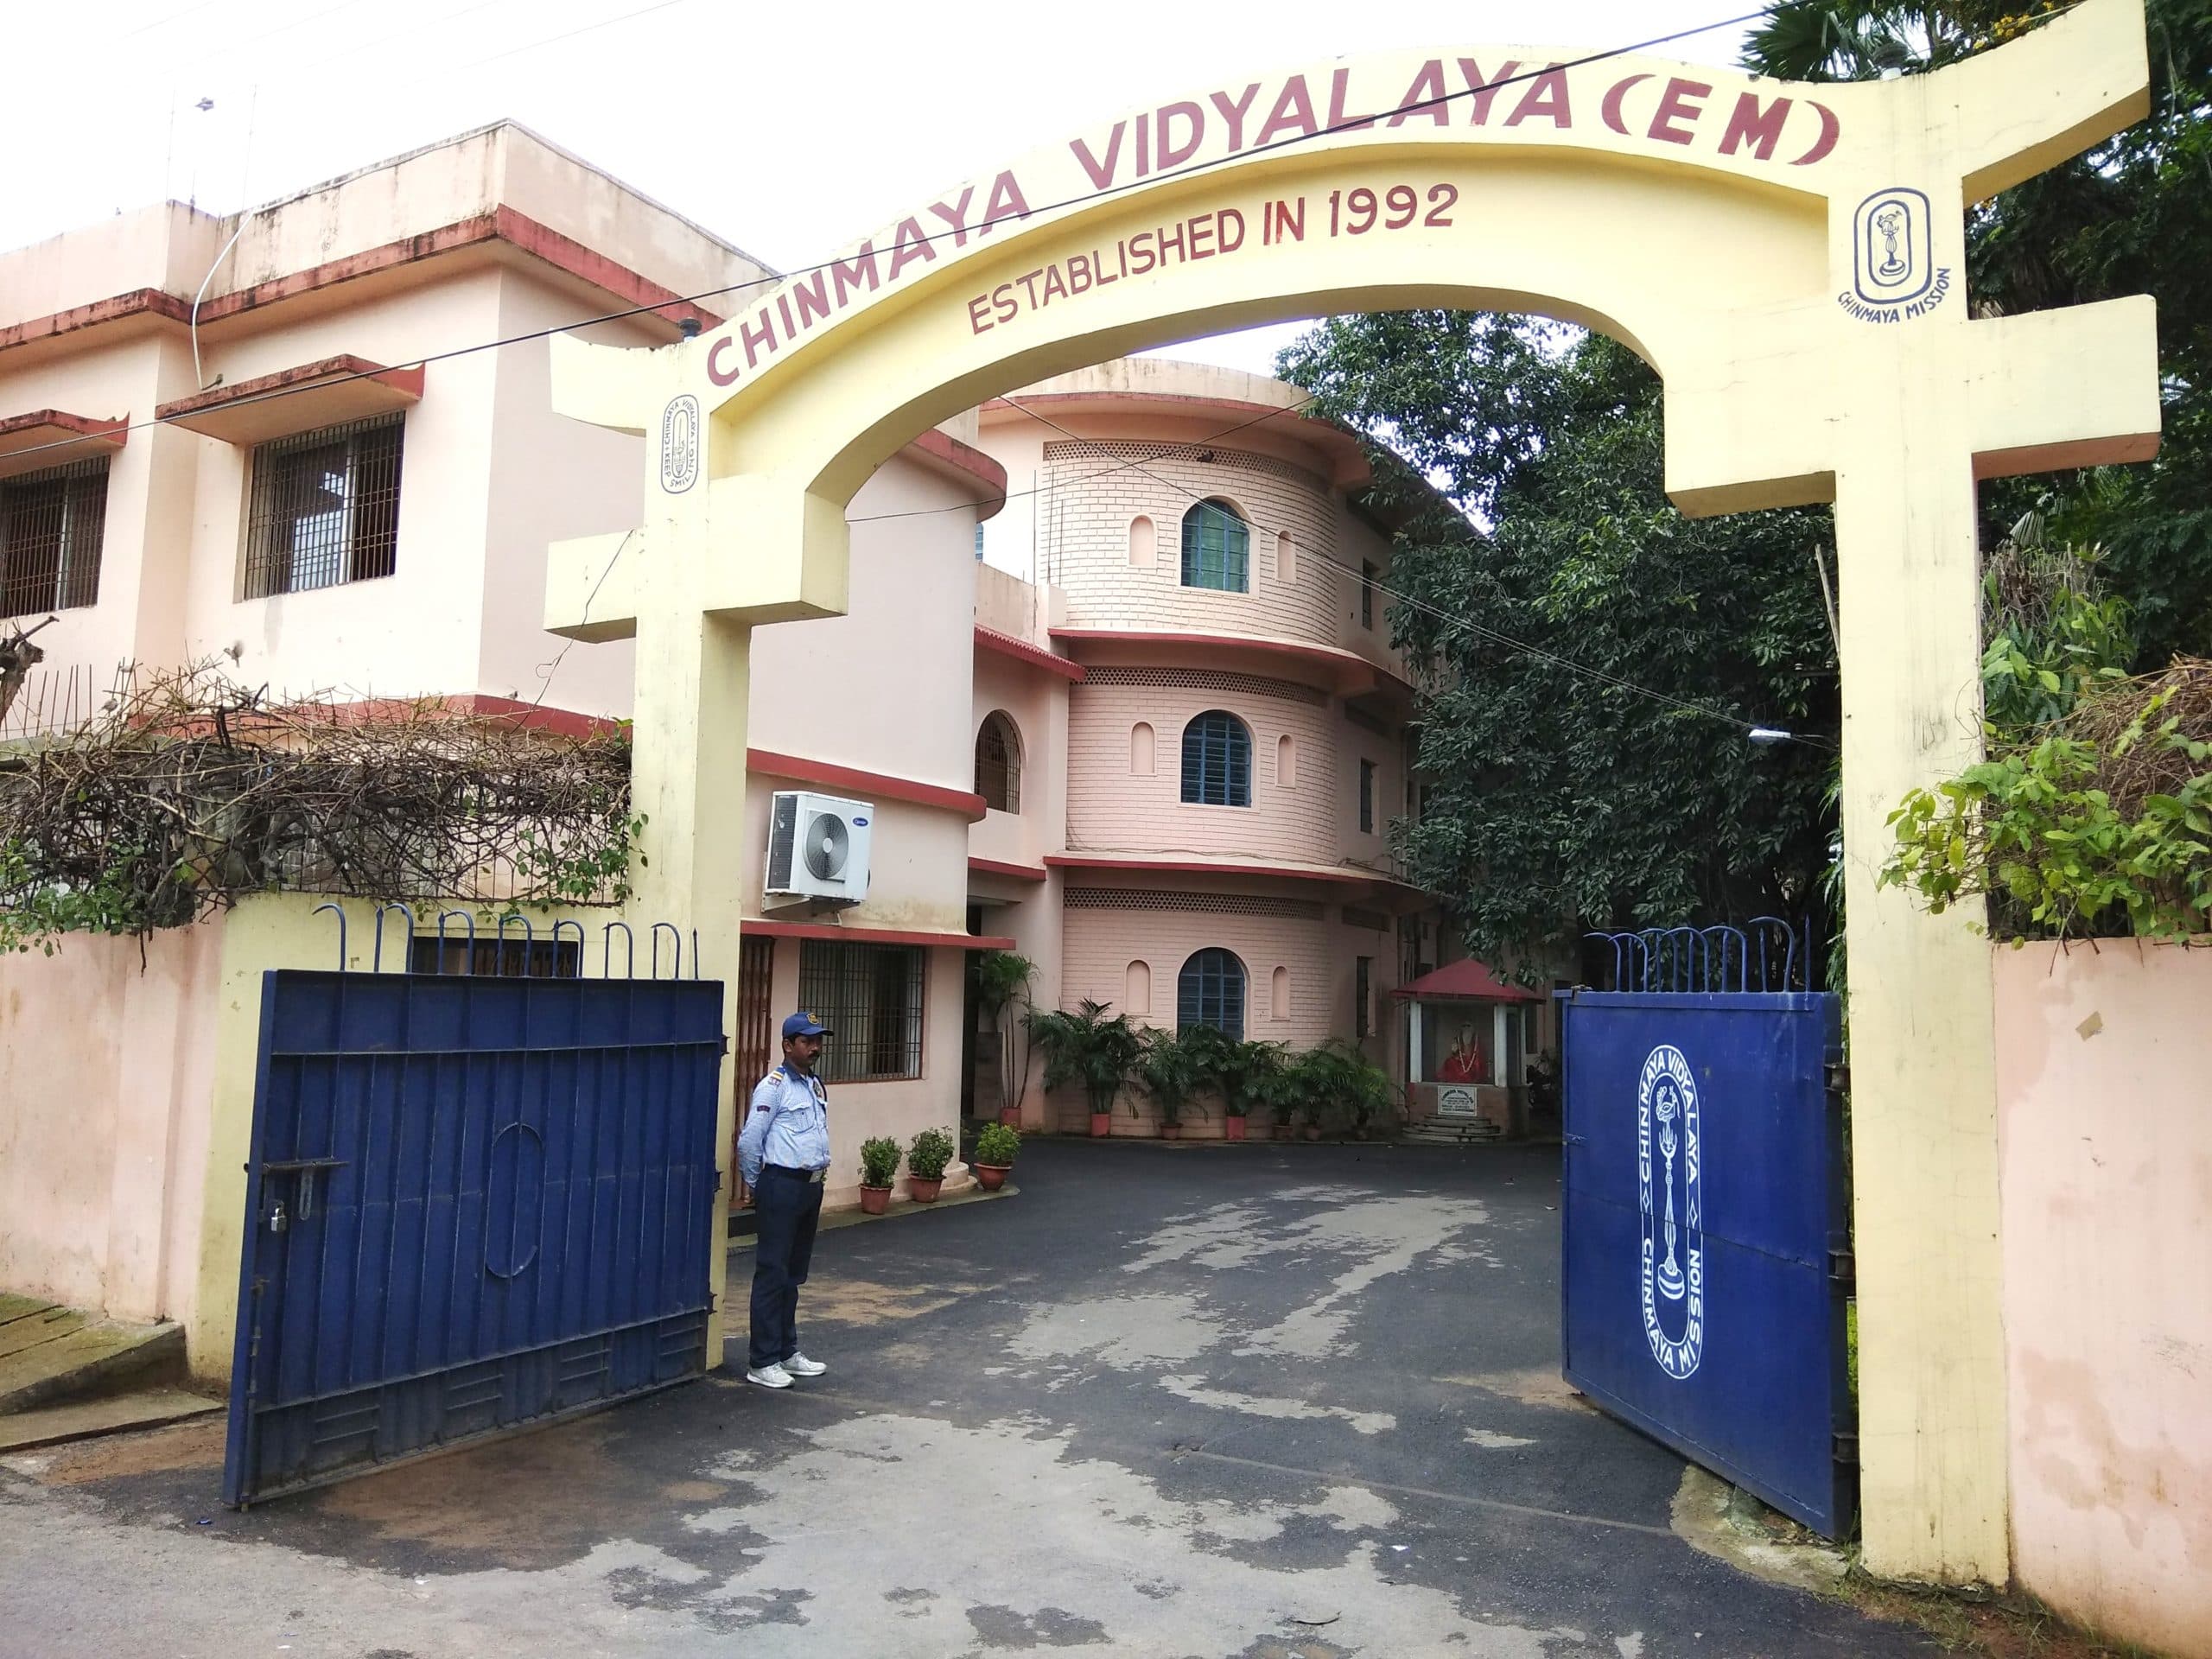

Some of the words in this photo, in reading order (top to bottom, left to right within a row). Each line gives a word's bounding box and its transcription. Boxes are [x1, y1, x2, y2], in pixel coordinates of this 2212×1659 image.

[707, 170, 1031, 386] CHINMAYA
[1069, 57, 1572, 191] VIDYALAYA
[1602, 73, 1840, 166] (EM)
[968, 208, 1244, 335] ESTABLISHED
[1262, 197, 1305, 246] IN
[1329, 183, 1459, 238] 1992
[1838, 291, 1900, 323] CHINMAYA
[1906, 268, 1951, 320] MISSION
[670, 448, 696, 487] SMILING
[1640, 1052, 1664, 1185] CHINMAYA
[1668, 1050, 1697, 1185] VIDYALAYA
[1643, 1237, 1674, 1370] CHINMAYA
[1679, 1249, 1701, 1373] MISSION
